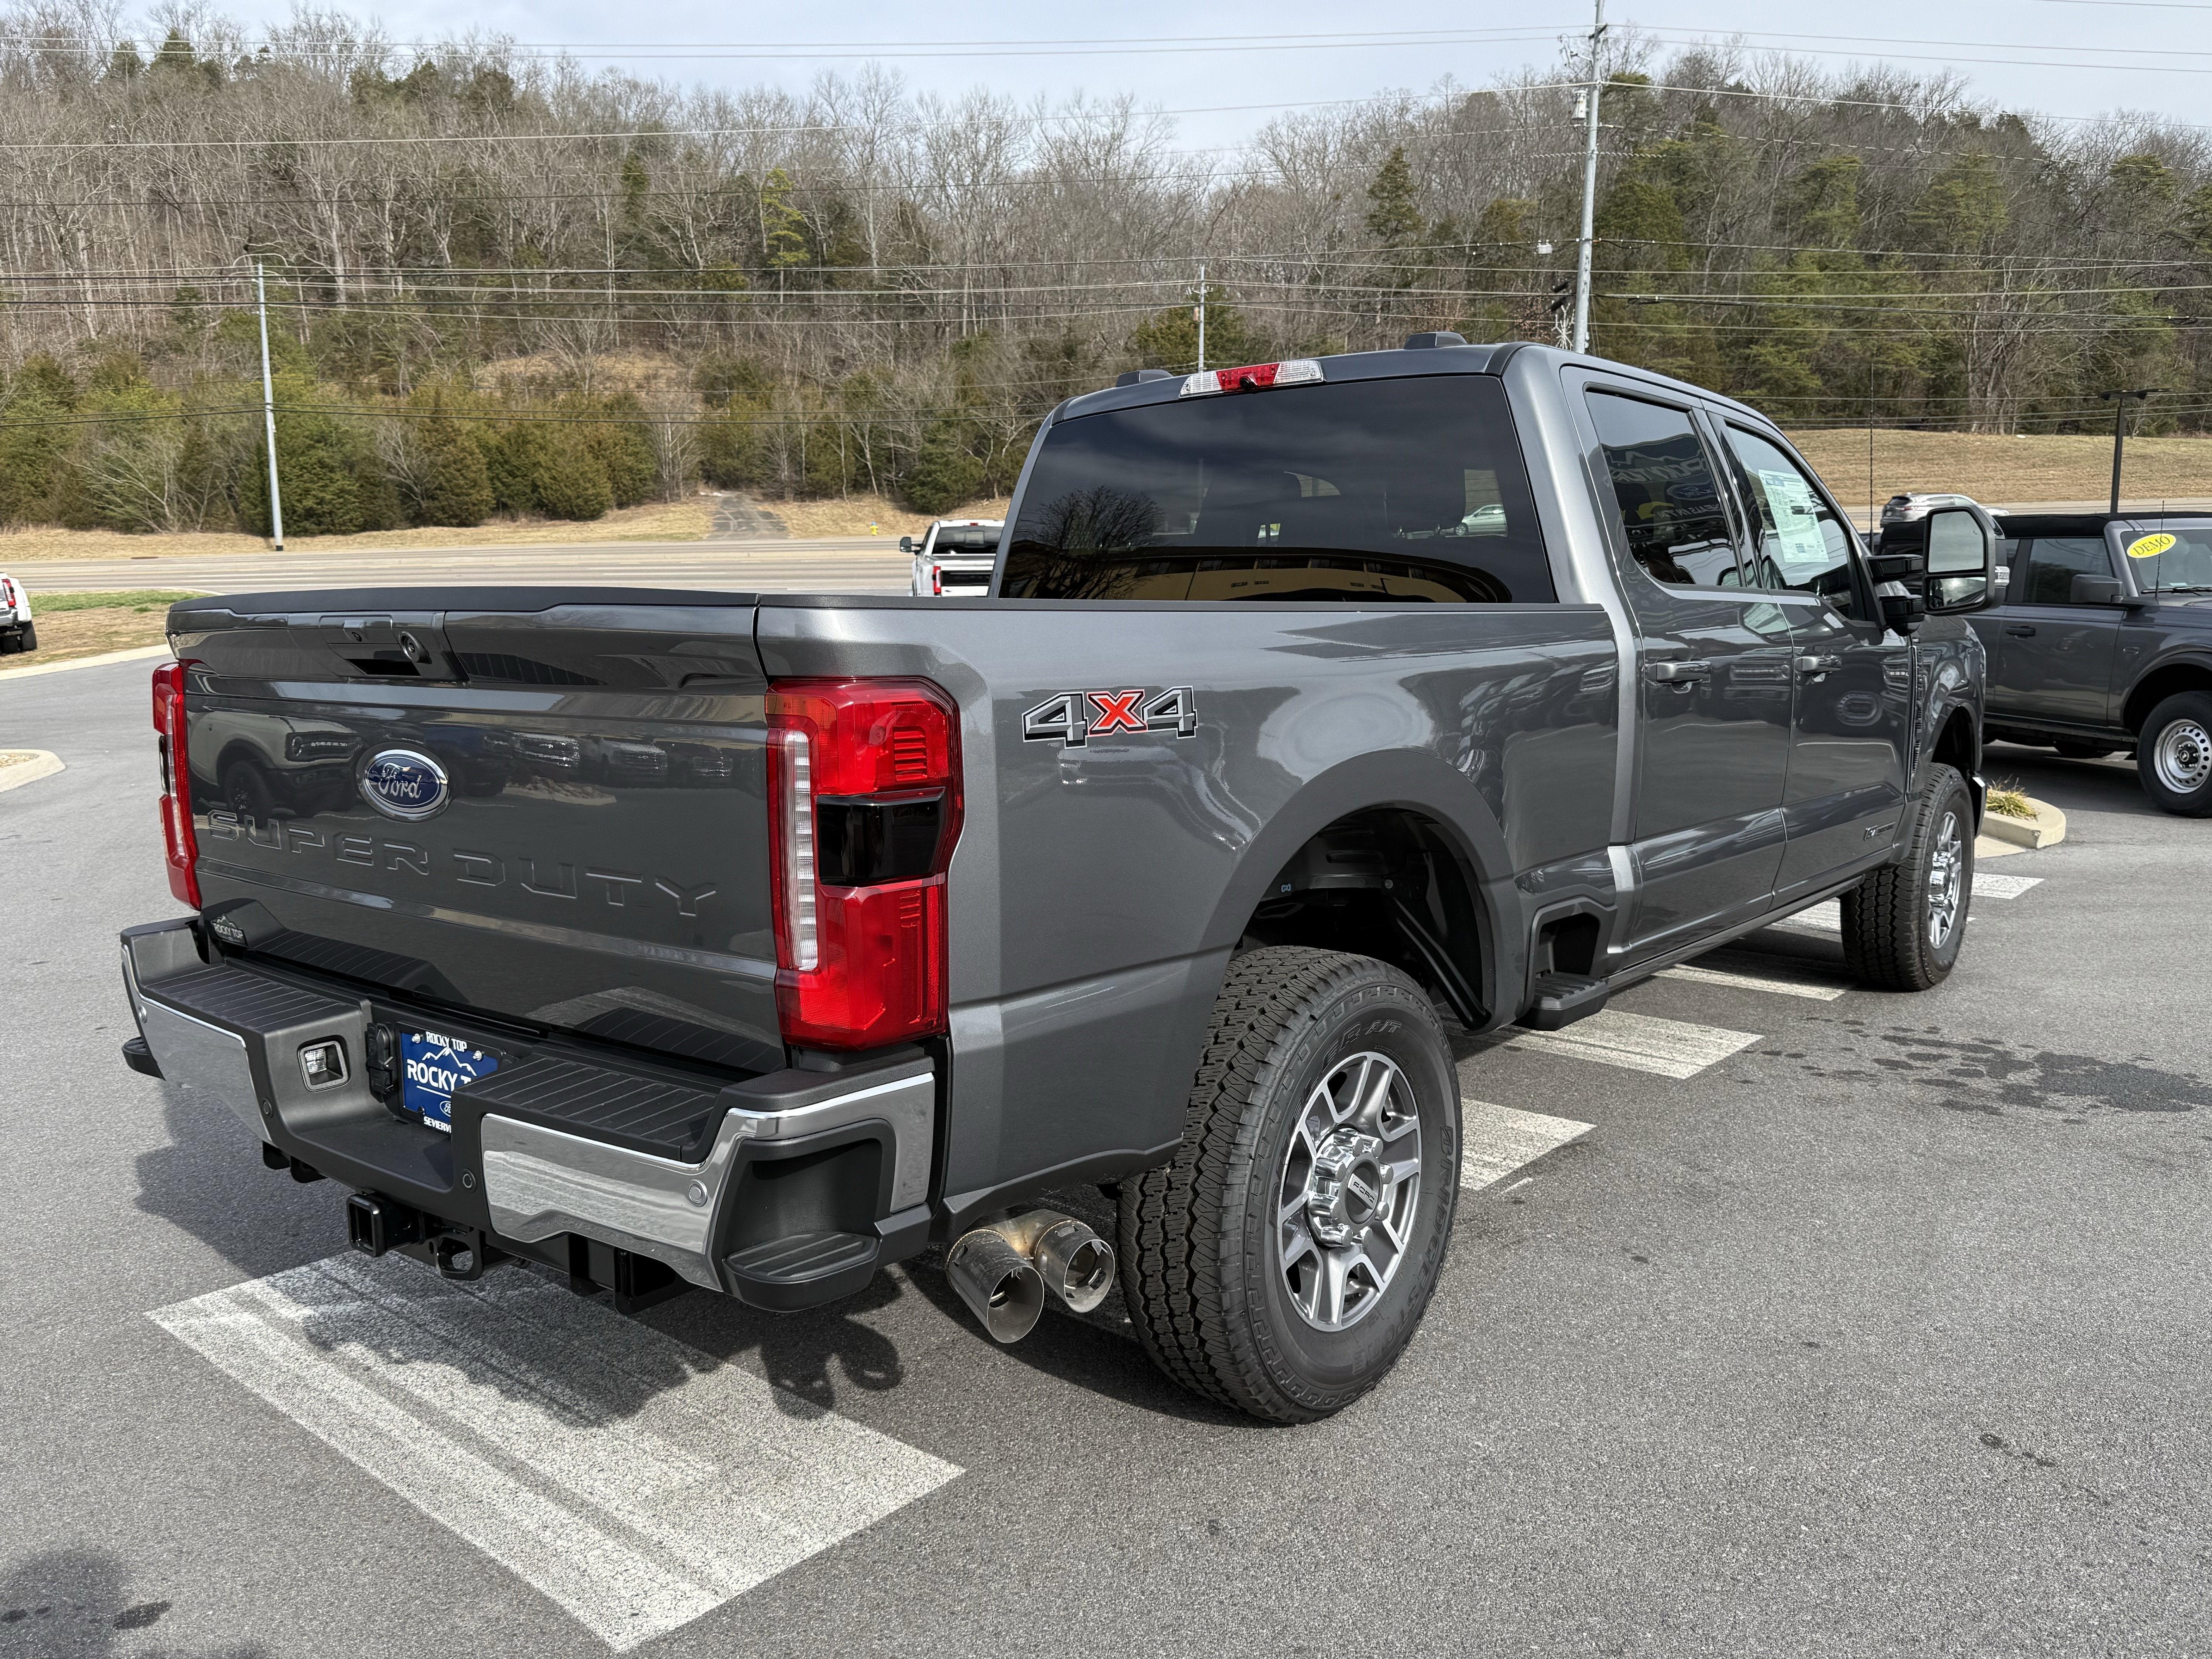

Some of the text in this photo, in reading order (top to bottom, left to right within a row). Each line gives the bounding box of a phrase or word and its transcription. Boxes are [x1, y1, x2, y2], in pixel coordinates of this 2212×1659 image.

[2133, 536, 2171, 555] DEMO
[378, 762, 422, 799] Ford
[207, 810, 718, 918] SUPER DUTY
[213, 923, 244, 939] ROCKY TOP
[1365, 1019, 1403, 1035] A/T
[426, 1031, 467, 1053] ROCKY TOP
[407, 1059, 458, 1092] ROCKY
[1353, 1181, 1375, 1203] FORD
[1352, 1126, 1455, 1374] BRIDGESTONE
